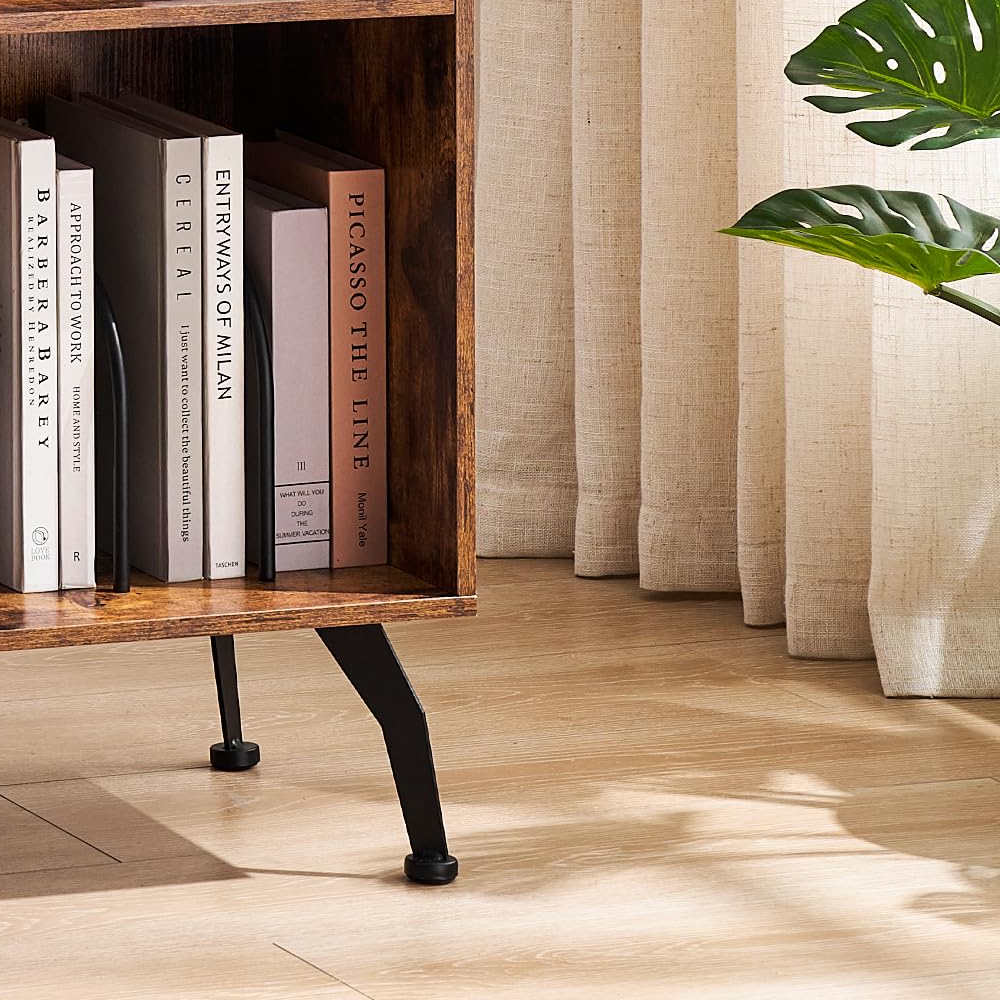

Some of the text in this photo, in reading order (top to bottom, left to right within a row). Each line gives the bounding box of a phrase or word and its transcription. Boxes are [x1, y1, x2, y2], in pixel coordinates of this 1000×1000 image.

[175, 174, 192, 301] CEREAL
[70, 202, 82, 364] APPROACH TO WORK
[215, 169, 233, 400] ENTRYWAYS OF MILAN
[27, 216, 36, 406] REALIZED BY HENREDON
[37, 188, 51, 450] BARBERA BAREY
[179, 330, 190, 352] just
[348, 191, 370, 470] PICASSO THE LINE
[181, 354, 189, 383] want
[181, 384, 189, 396] to
[72, 386, 81, 472] HOME AND STYLE
[181, 397, 191, 434] collect
[181, 435, 191, 454] the
[181, 455, 192, 506] beautiful
[279, 491, 296, 499] WHAT
[311, 488, 325, 496] YOU
[180, 507, 192, 543] things
[290, 509, 314, 518] DURING
[357, 492, 368, 548] Monil Yale
[275, 528, 330, 539] SUMMER VACATION
[31, 553, 50, 561] BOOK
[73, 551, 81, 562] R
